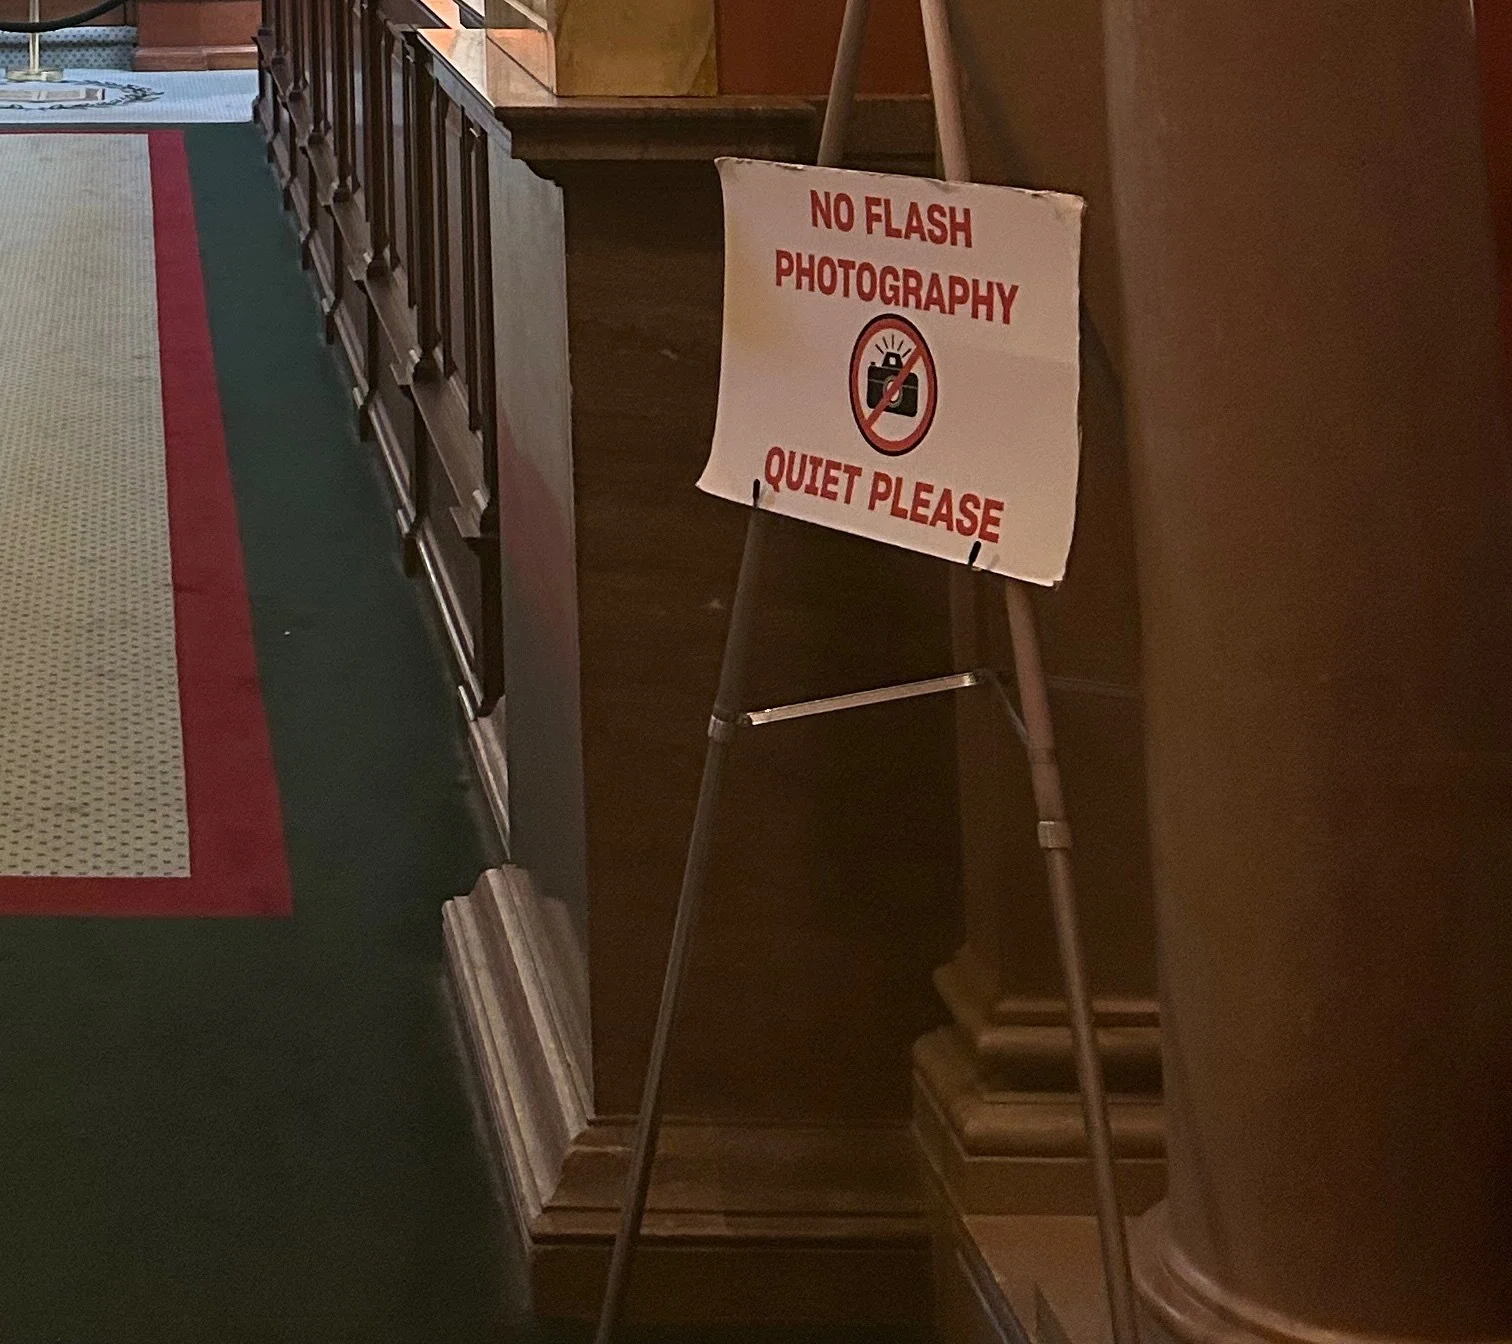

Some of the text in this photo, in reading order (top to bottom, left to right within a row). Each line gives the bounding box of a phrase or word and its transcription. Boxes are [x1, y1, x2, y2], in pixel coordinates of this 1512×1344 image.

[810, 189, 972, 248] NO FLASH
[775, 249, 1019, 325] PHOTOGRAPHY
[764, 446, 1004, 544] QUIET PLEASE
